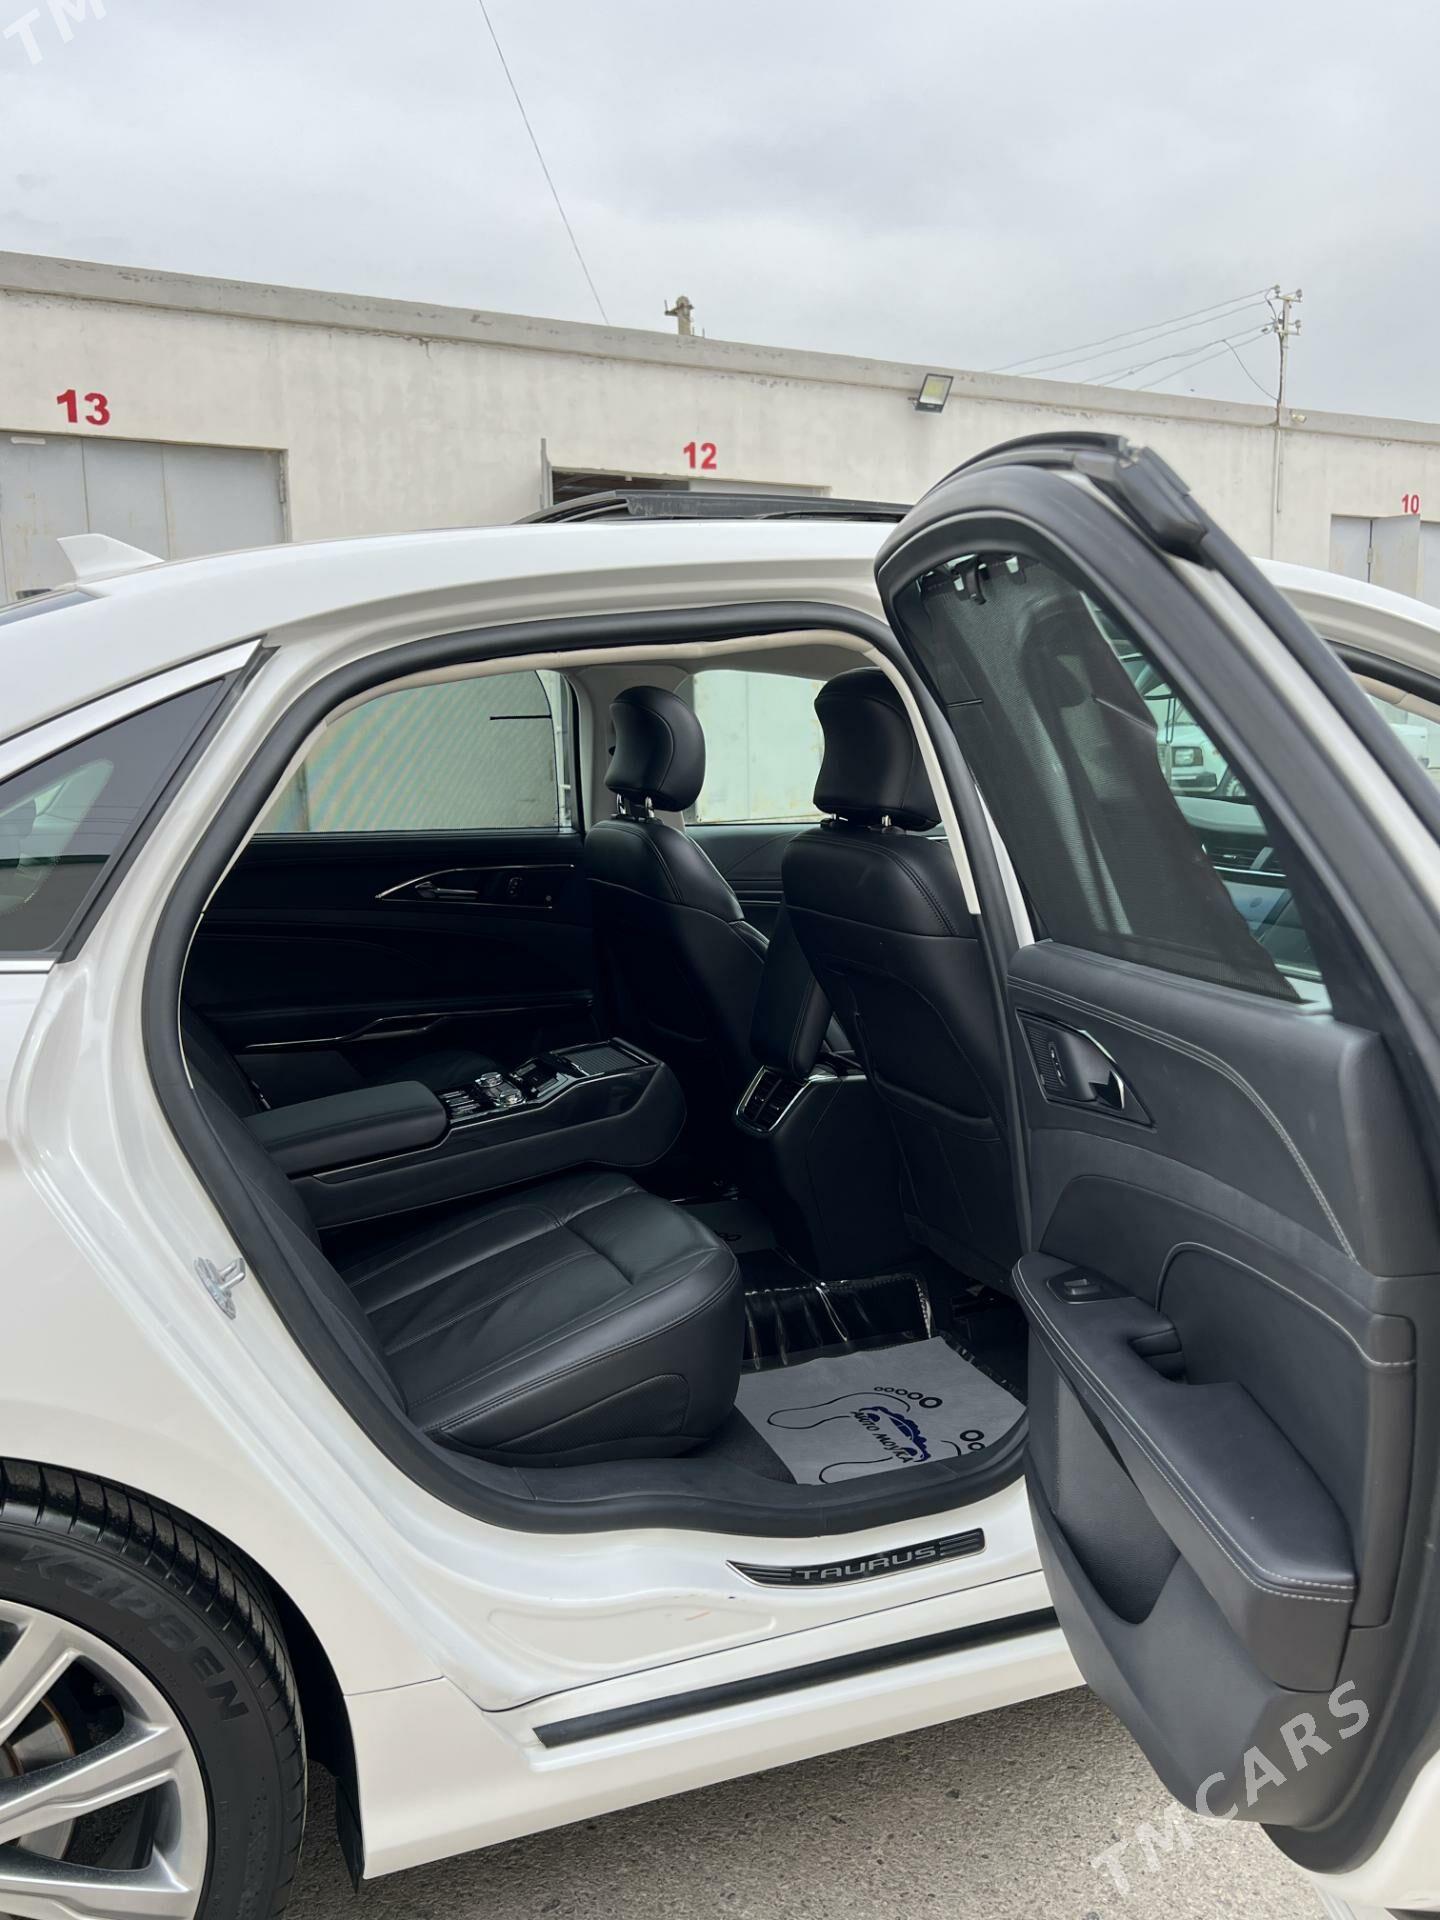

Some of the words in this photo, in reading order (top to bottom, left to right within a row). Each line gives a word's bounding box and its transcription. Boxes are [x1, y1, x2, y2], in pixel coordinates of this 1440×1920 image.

[57, 389, 110, 426] 13
[683, 442, 717, 470] 12
[1402, 494, 1420, 515] 10
[796, 1546, 936, 1580] TAURUS
